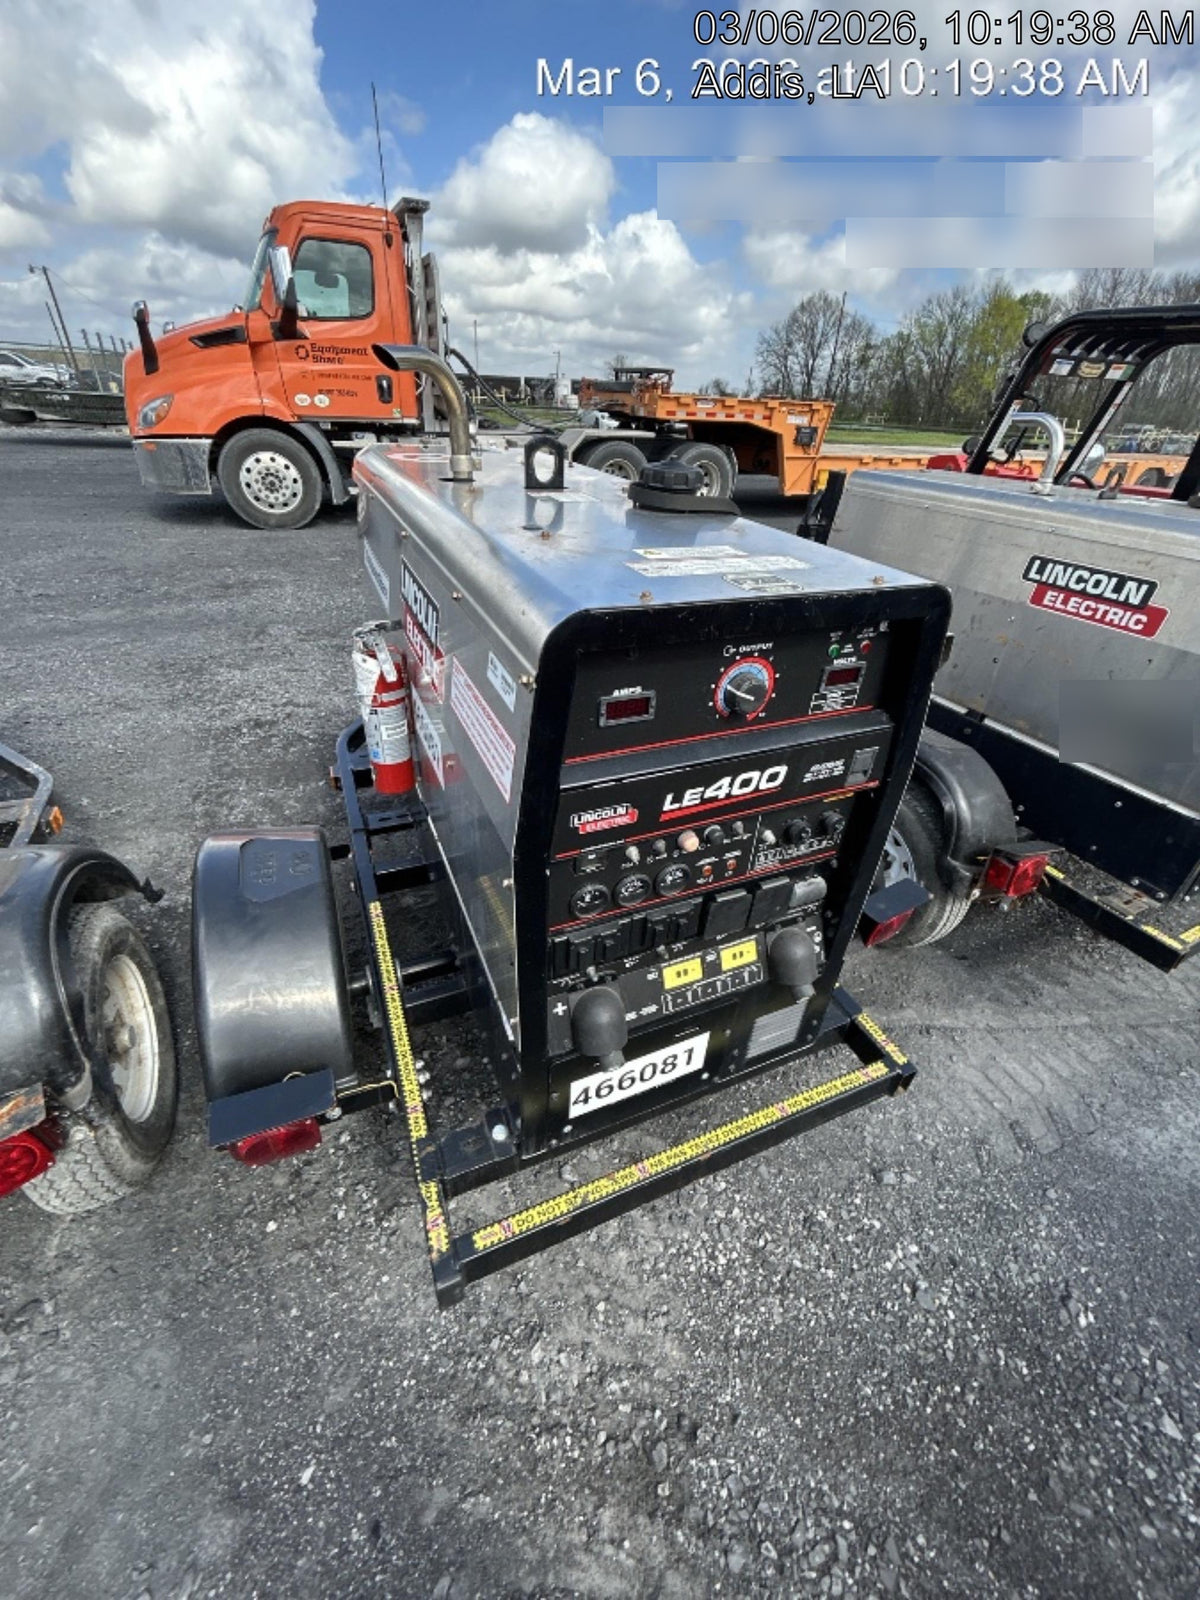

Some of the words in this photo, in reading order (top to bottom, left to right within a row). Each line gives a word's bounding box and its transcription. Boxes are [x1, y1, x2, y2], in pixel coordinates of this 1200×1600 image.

[310, 342, 369, 356] Equipment
[311, 353, 344, 364] Share
[1027, 559, 1149, 605] LINCOLN
[401, 562, 438, 655] LINCOLN
[1042, 590, 1148, 631] ELECTRIC
[612, 686, 643, 697] AMPS
[662, 764, 788, 812] LE400
[573, 805, 629, 828] LINCOLN
[571, 1046, 695, 1107] 466081
[515, 1214, 534, 1227] DO
[536, 1202, 561, 1218] NOT
[666, 1148, 686, 1161] PAS
[721, 1116, 760, 1138] DEBOUT
